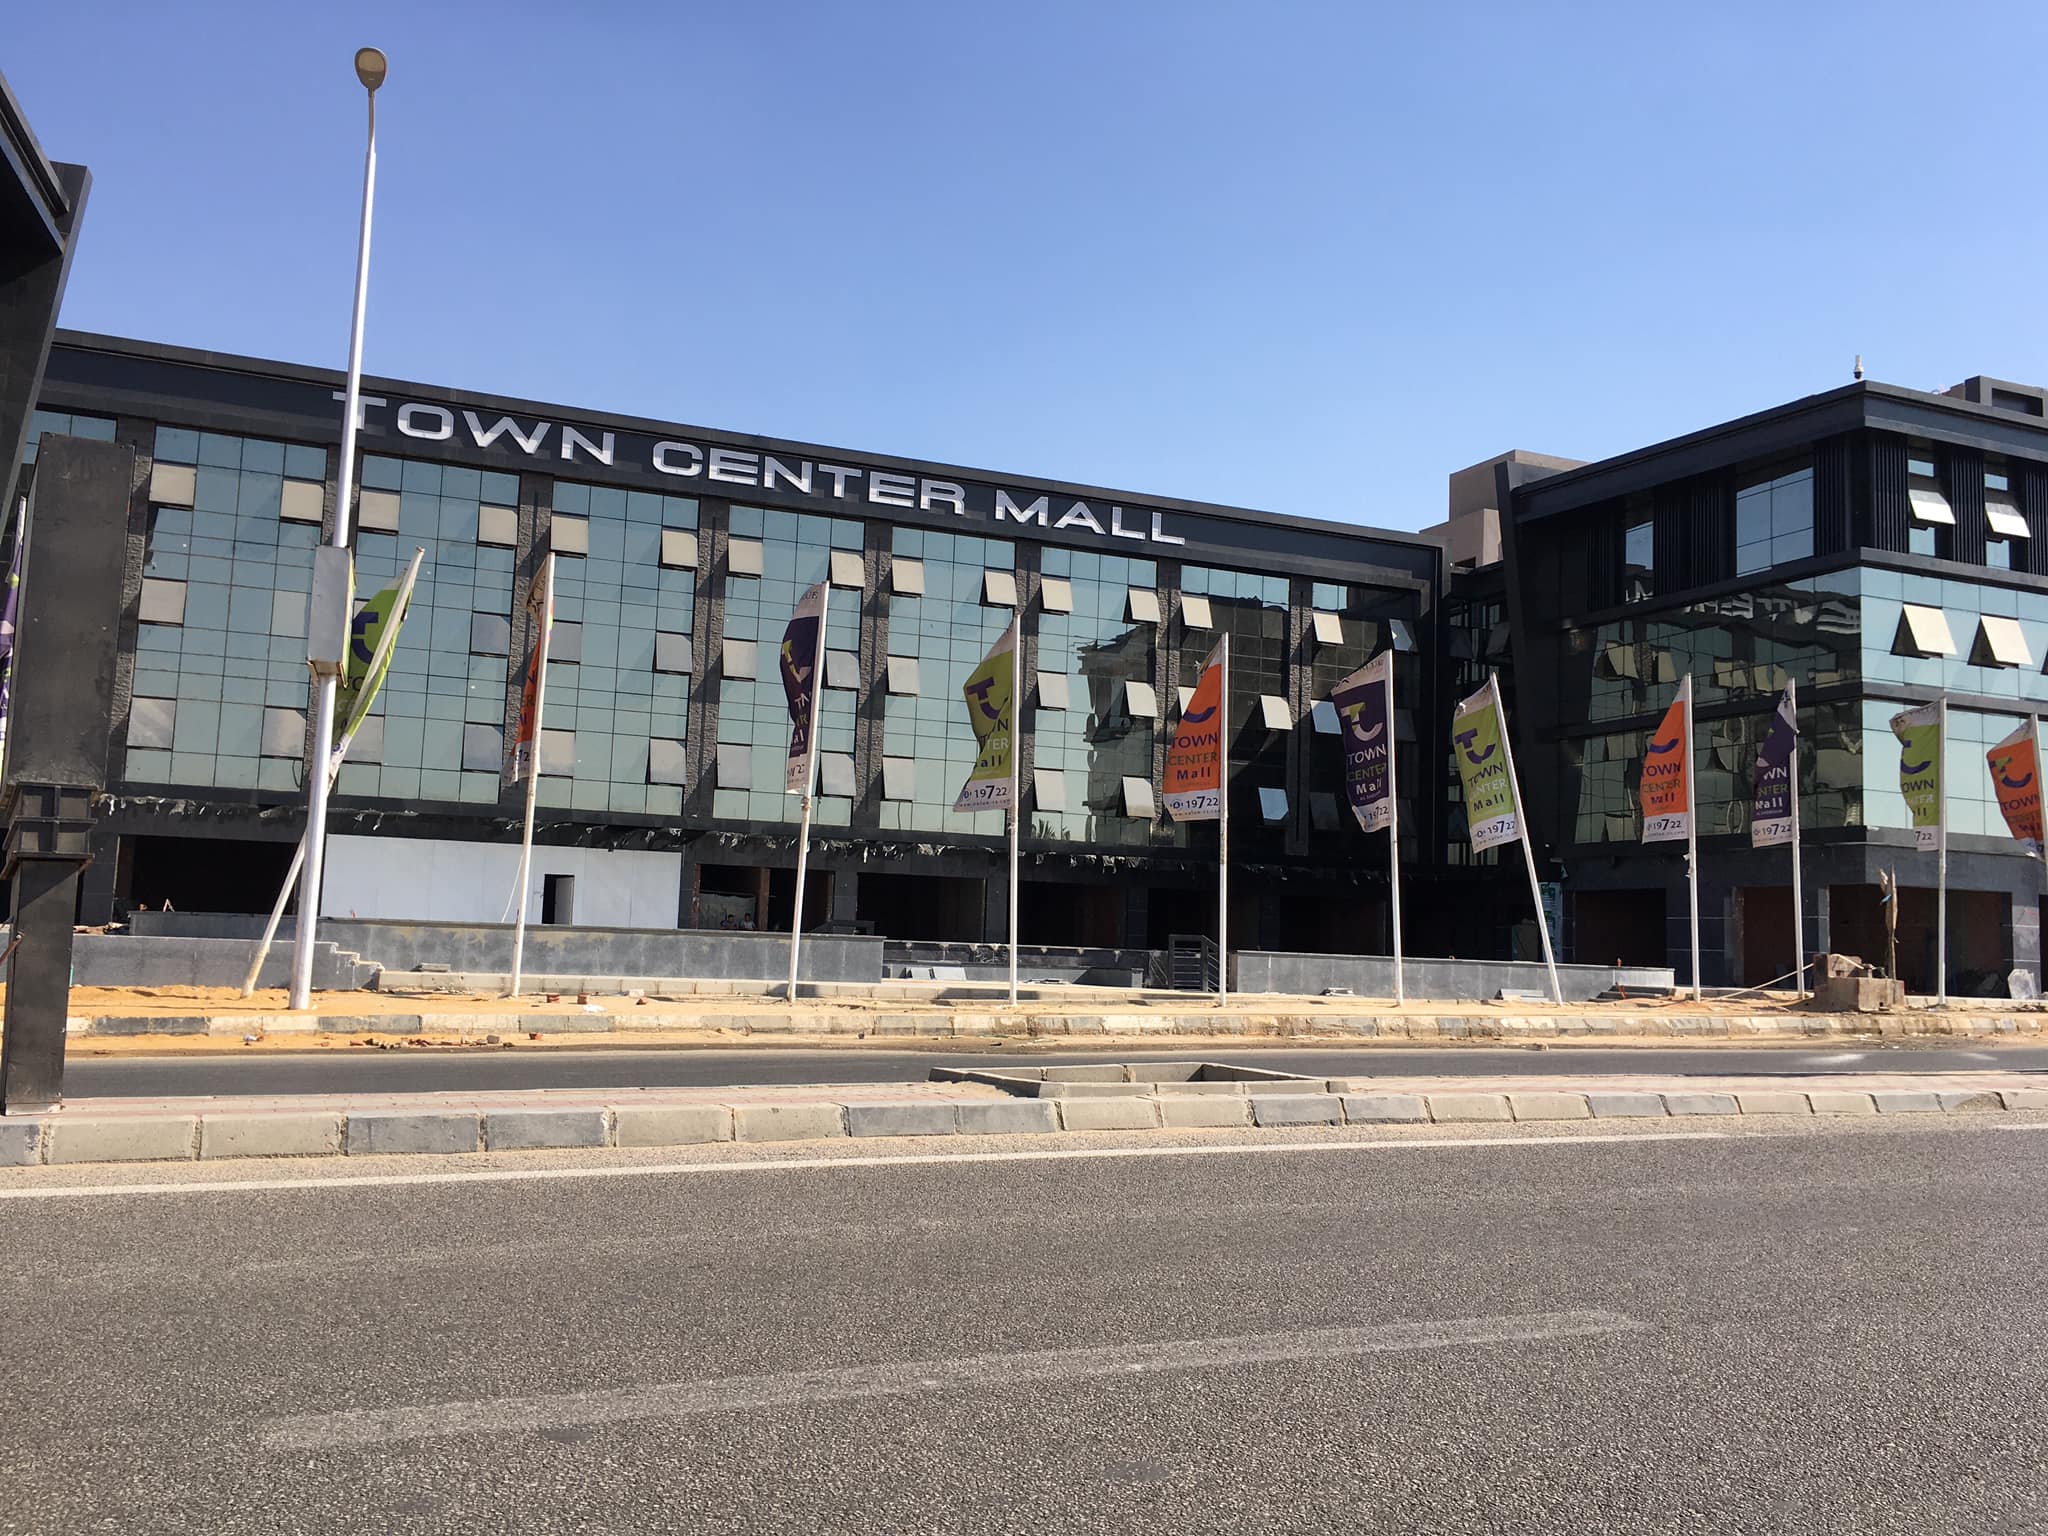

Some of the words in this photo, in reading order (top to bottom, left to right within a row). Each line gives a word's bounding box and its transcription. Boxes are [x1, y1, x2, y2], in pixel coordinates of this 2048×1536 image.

[332, 391, 615, 466] TOWN
[652, 440, 965, 515] CENTER
[995, 489, 1185, 545] MALL
[1171, 732, 1218, 750] TOWN
[1168, 751, 1217, 766] CENTER
[1346, 743, 1387, 766] TOWN
[1177, 766, 1211, 780] Mall
[974, 785, 1008, 800] 19722
[1902, 778, 1935, 794] OWN
[1186, 796, 1219, 809] 19722
[1473, 793, 1505, 812] Mall
[1653, 818, 1683, 831] 19722
[1762, 823, 1792, 836] 19722
